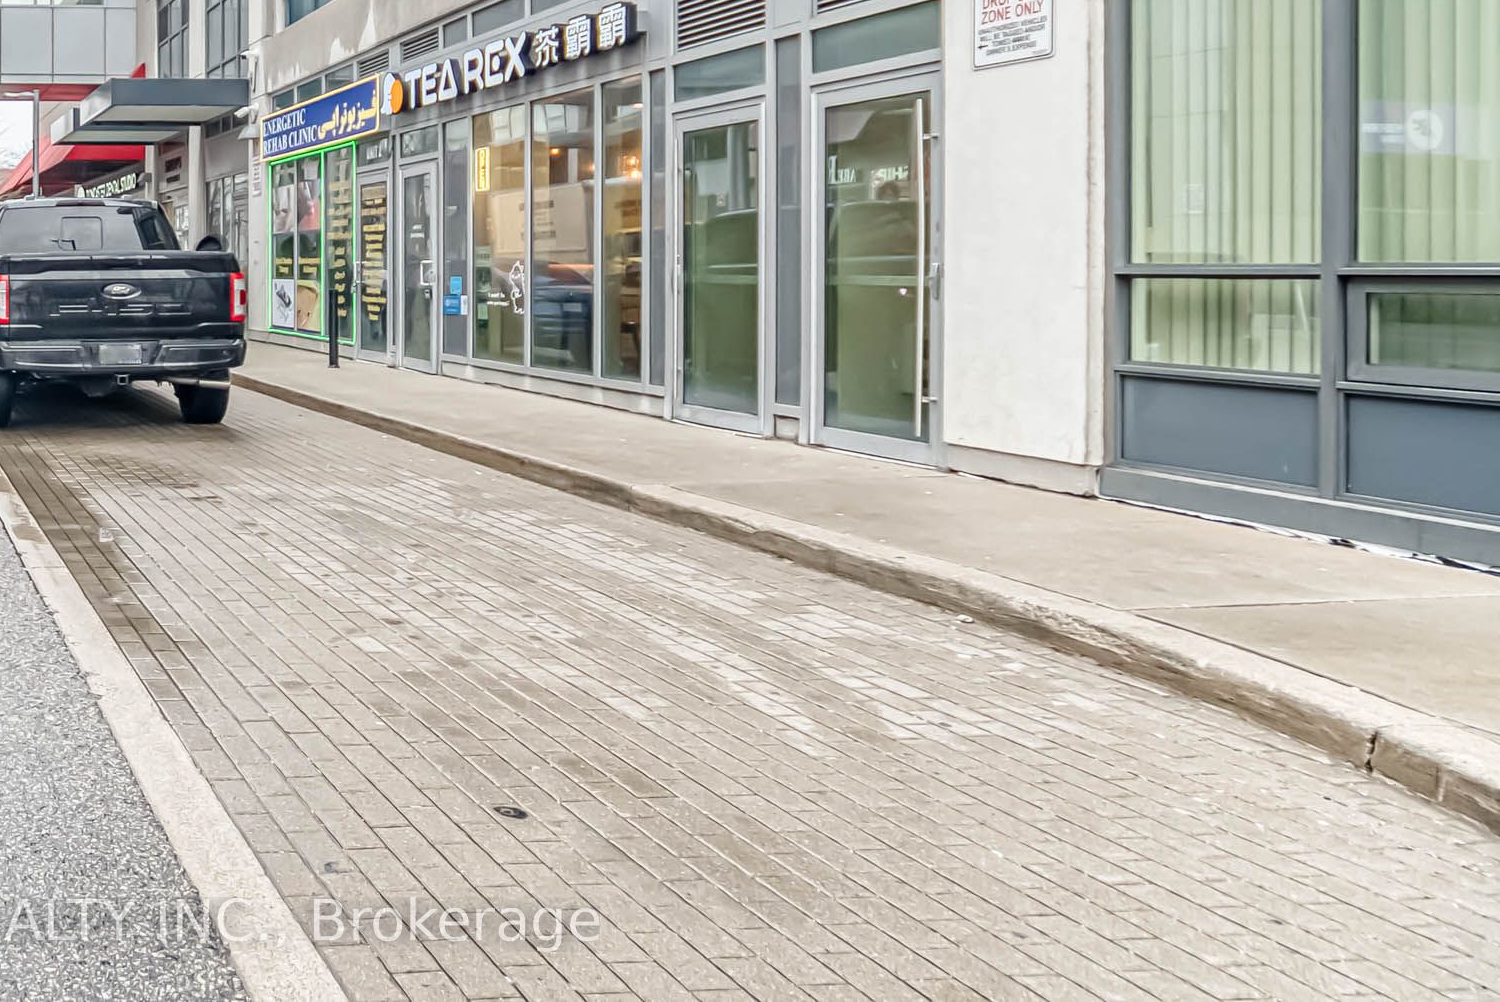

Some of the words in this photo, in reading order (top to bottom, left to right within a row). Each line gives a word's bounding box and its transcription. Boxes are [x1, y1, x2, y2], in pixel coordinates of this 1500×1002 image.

[981, 6, 1012, 25] ZONE
[1015, 0, 1044, 17] ONLY
[463, 31, 527, 95] REX
[263, 108, 306, 136] ENERGETIC
[263, 135, 288, 155] REHAB
[288, 125, 317, 148] CLINIC
